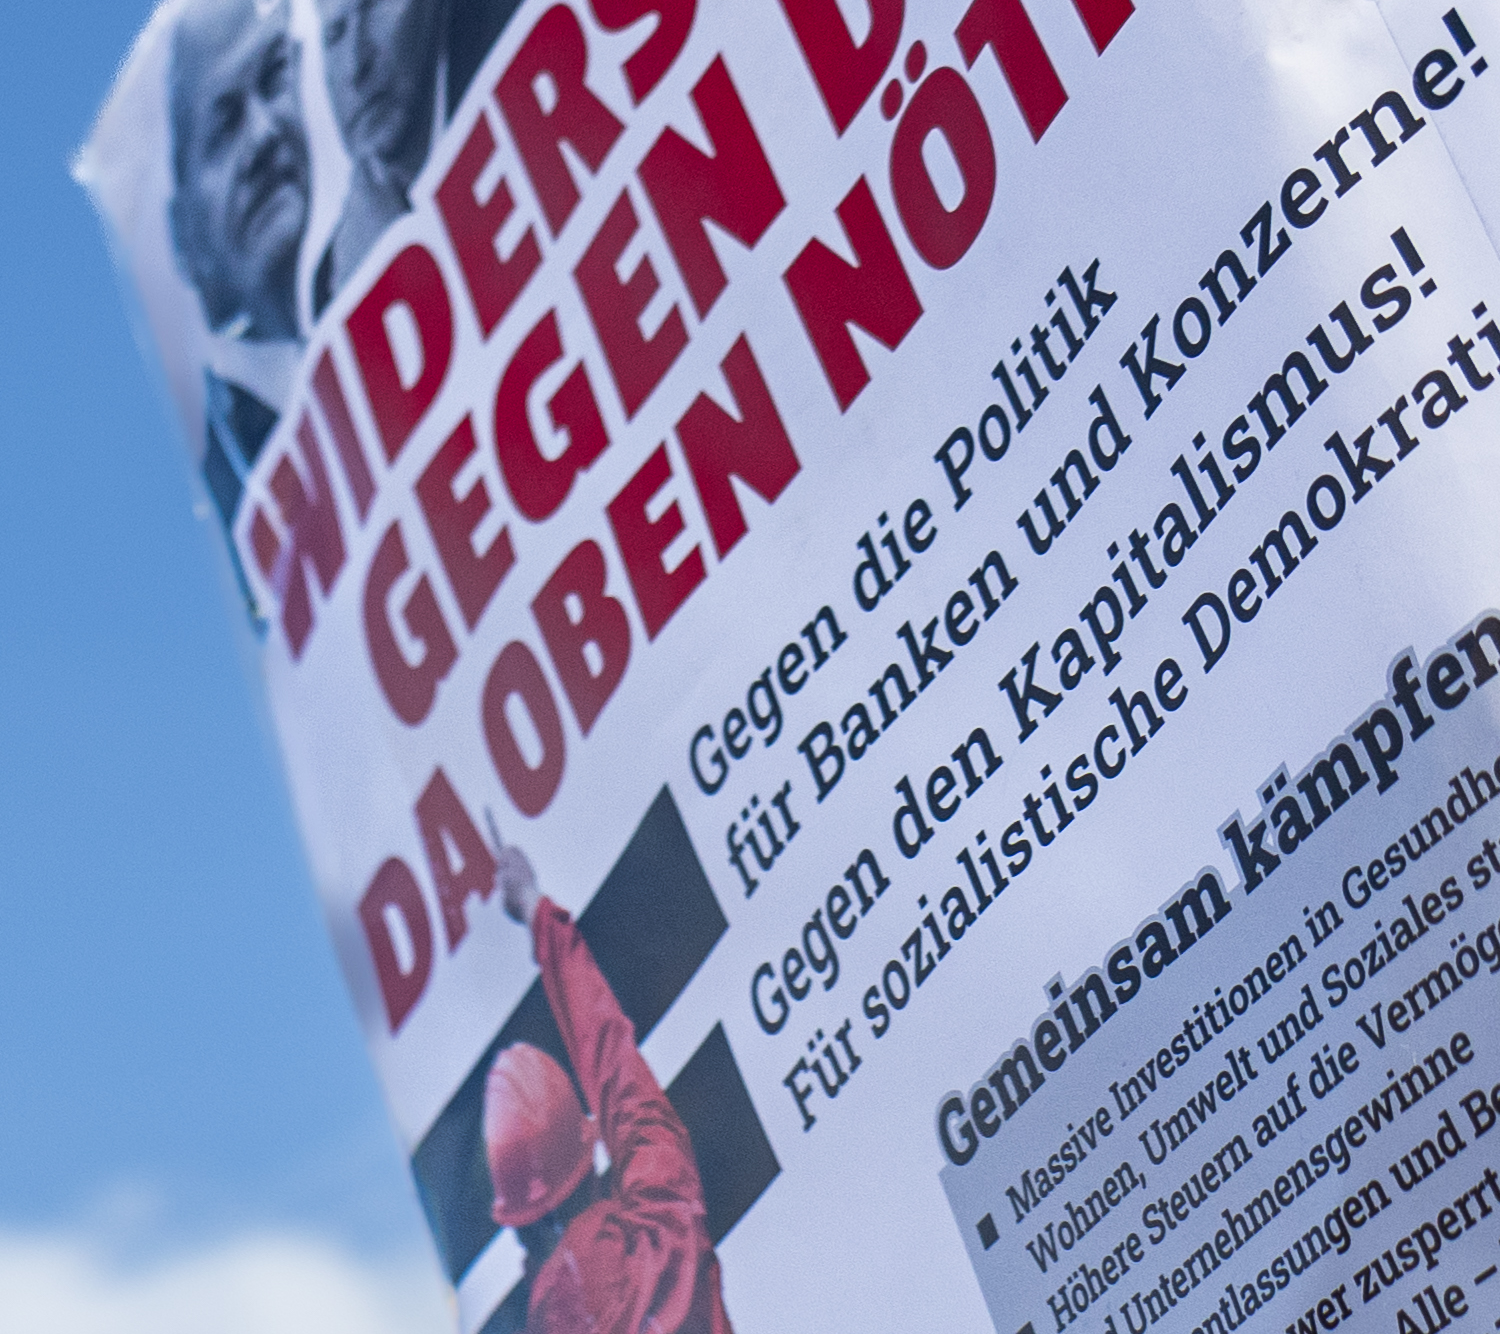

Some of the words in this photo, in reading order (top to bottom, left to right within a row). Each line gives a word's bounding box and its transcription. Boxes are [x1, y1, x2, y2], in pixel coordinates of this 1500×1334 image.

[334, 52, 788, 727] GEGEN
[689, 605, 847, 795] Gegen
[853, 498, 937, 611] die
[933, 258, 1117, 511] Politik
[726, 780, 800, 898] für
[797, 550, 1018, 803] Banken
[1016, 384, 1132, 555] und
[1119, 7, 1487, 419] Konzerne!
[358, 769, 498, 1035] DA
[480, 331, 802, 819] OBEN
[751, 848, 890, 1035] Gegen
[893, 727, 1003, 858] den
[998, 226, 1459, 743] Kapitalismus!
[783, 1018, 861, 1131] Für
[862, 658, 1188, 1038] sozialistische
[937, 872, 1232, 1165] Gemeinsam
[1005, 1107, 1113, 1223] Massive
[1108, 934, 1307, 1120] Investitionen
[1303, 901, 1343, 947] in
[1025, 1161, 1146, 1273] Wohnen,
[1138, 1046, 1258, 1164] Umwelt
[1257, 984, 1323, 1063] und
[1321, 876, 1463, 1007] Soziales
[1046, 1232, 1144, 1333] Höhere
[1142, 1135, 1252, 1245] Steuern
[1252, 1072, 1306, 1147] auf
[1309, 1042, 1359, 1099] die
[1389, 1109, 1466, 1191] und
